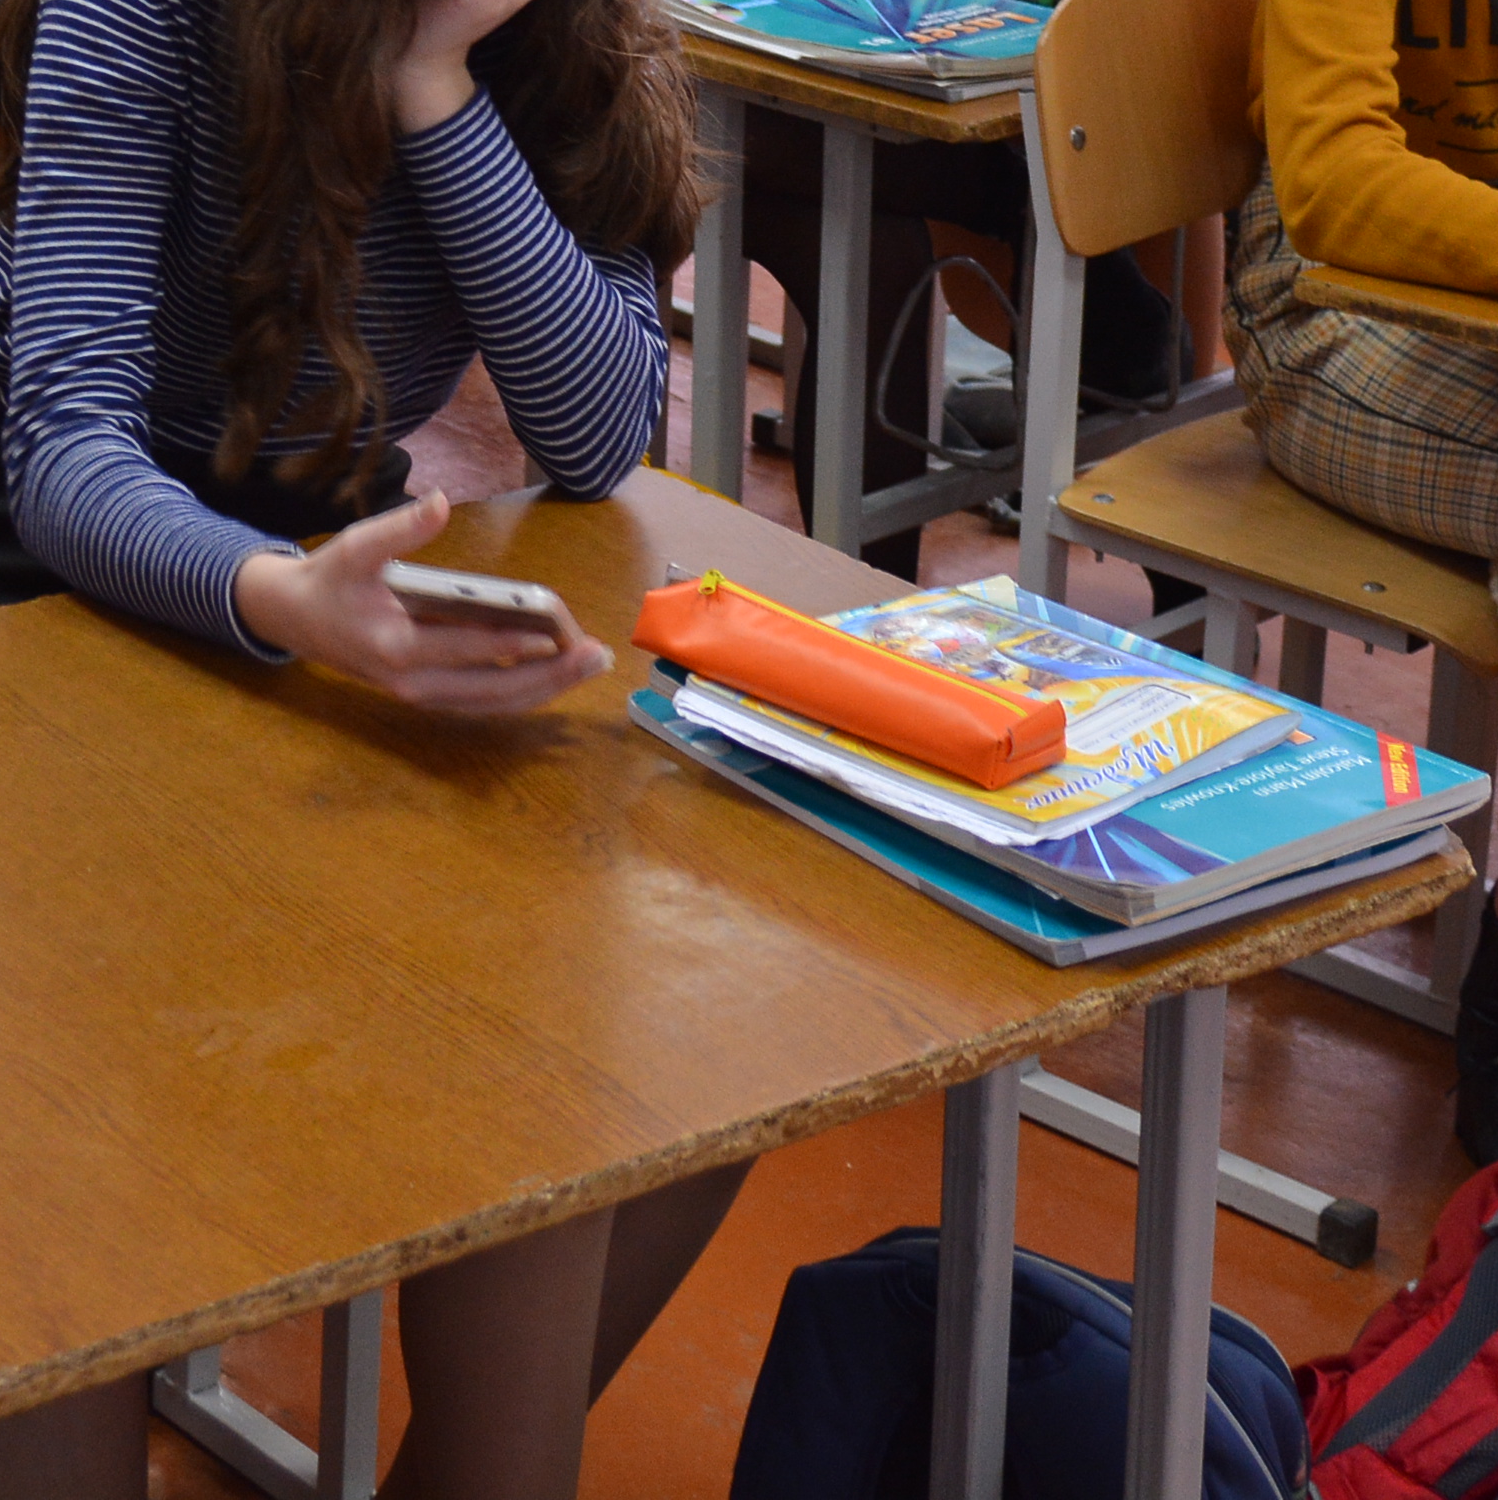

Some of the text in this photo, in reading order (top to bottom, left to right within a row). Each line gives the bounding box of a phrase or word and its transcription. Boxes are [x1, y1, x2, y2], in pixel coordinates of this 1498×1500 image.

[904, 11, 1040, 45] Laser
[1160, 745, 1350, 811] Steve Taylore-Knowles
[1252, 754, 1373, 798] Malcolm Mann
